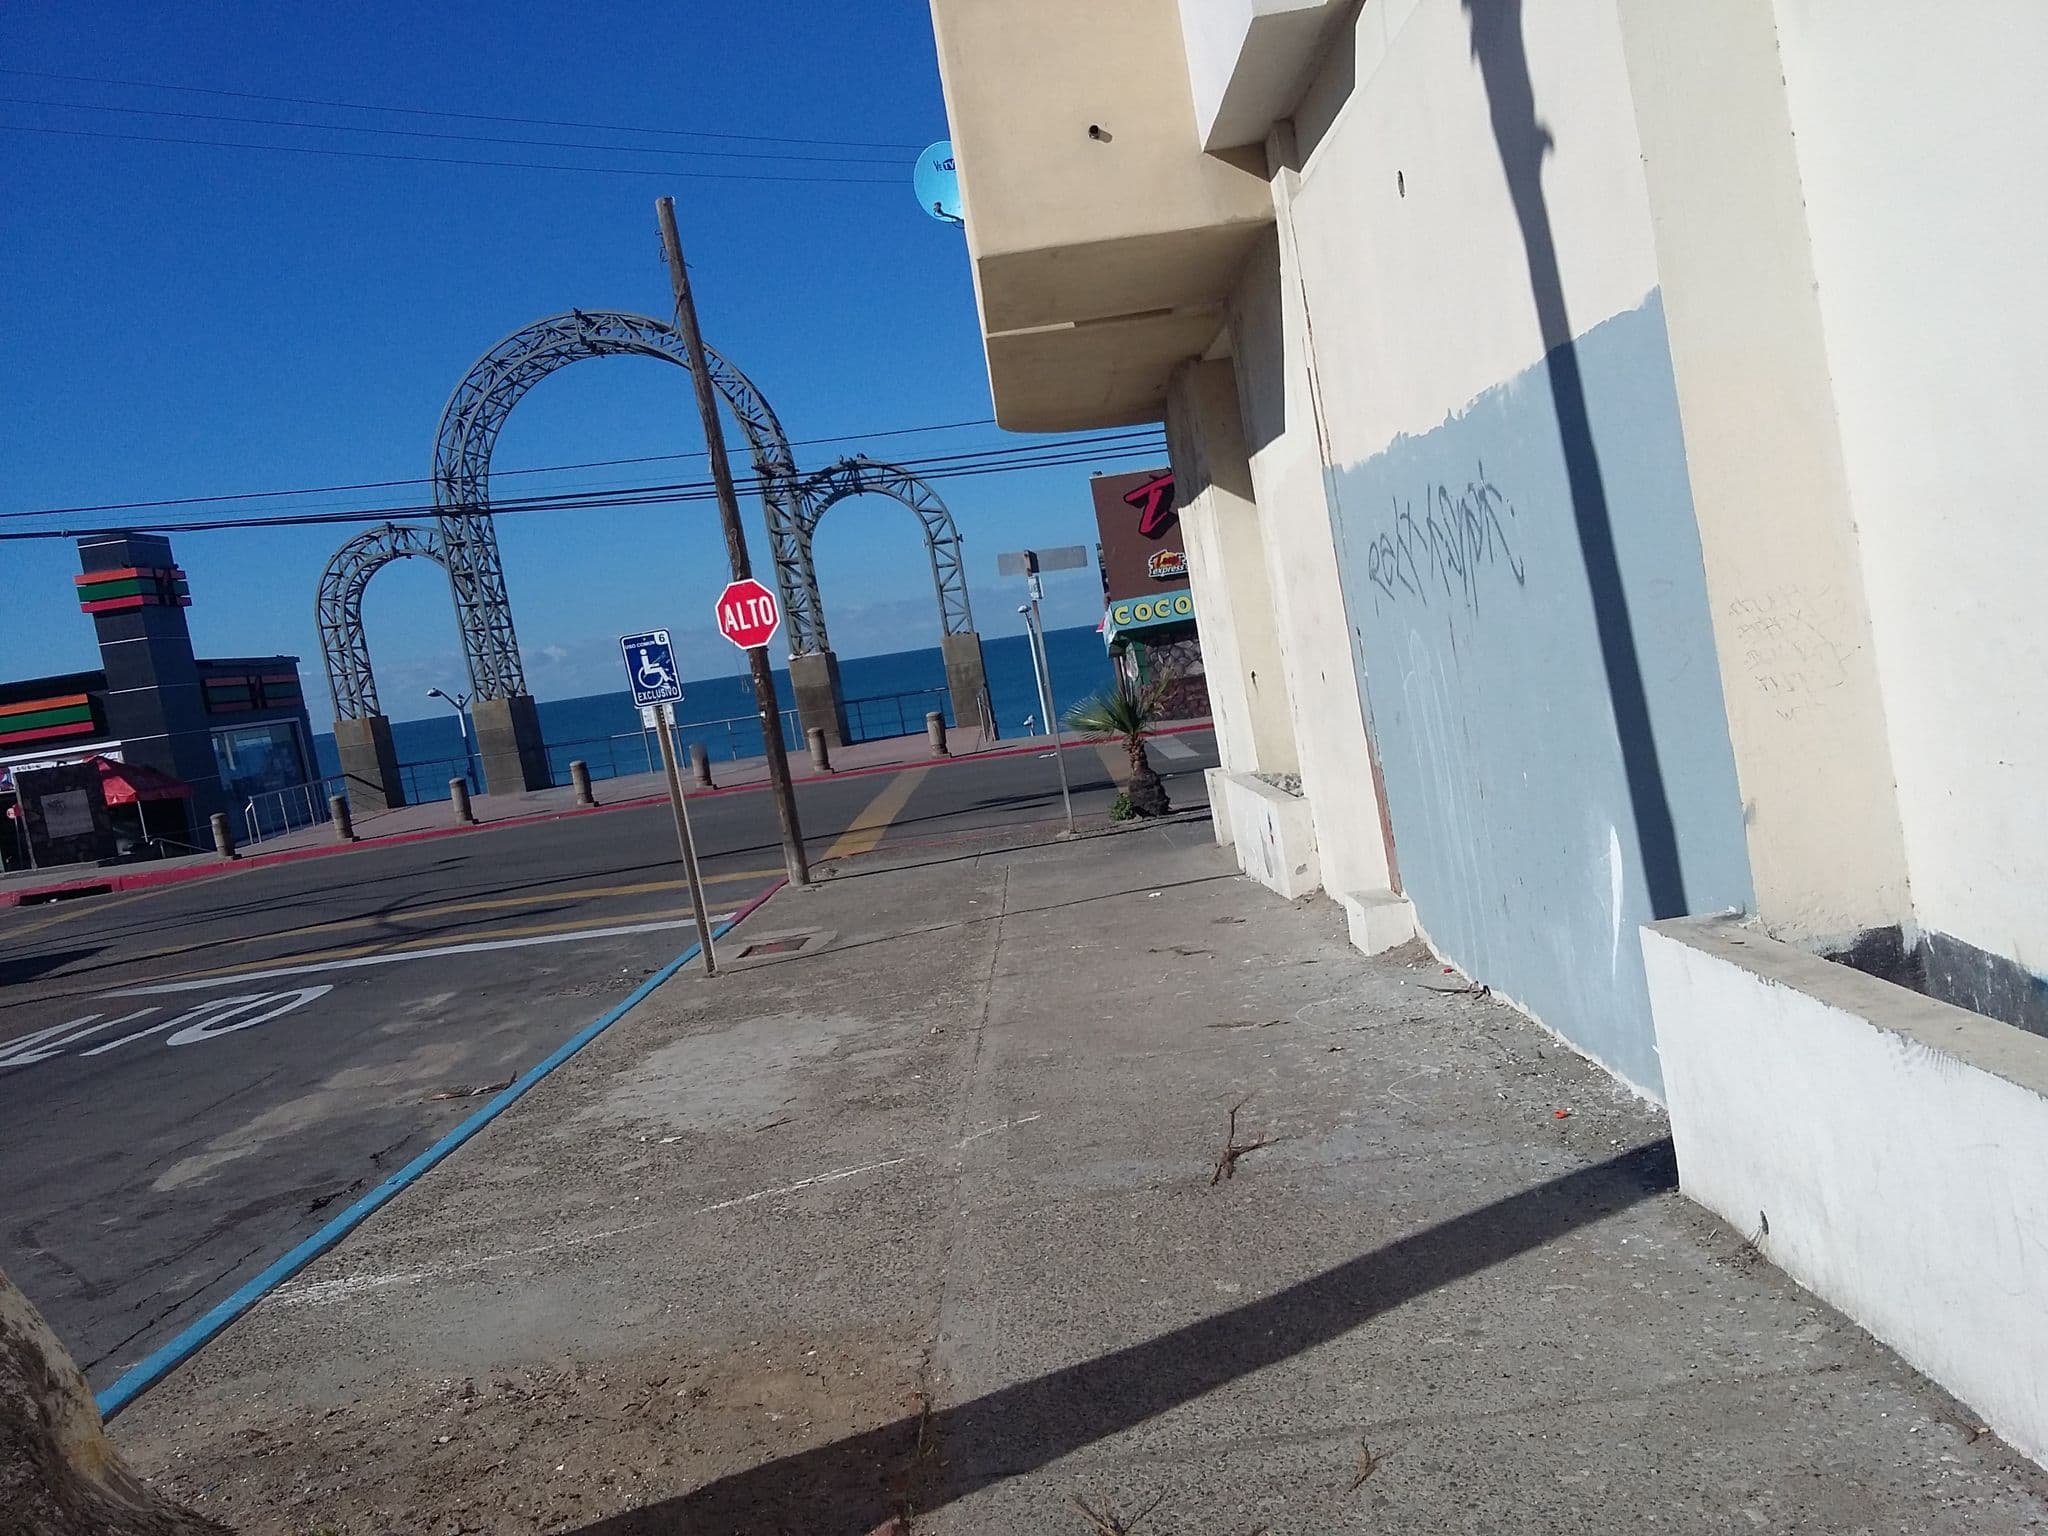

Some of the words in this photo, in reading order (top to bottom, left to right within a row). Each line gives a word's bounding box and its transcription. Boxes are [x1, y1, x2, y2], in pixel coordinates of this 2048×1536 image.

[724, 596, 773, 633] ALTO
[1113, 595, 1192, 625] COCO
[659, 633, 666, 642] 6
[638, 687, 678, 701] EXCLUSIVO
